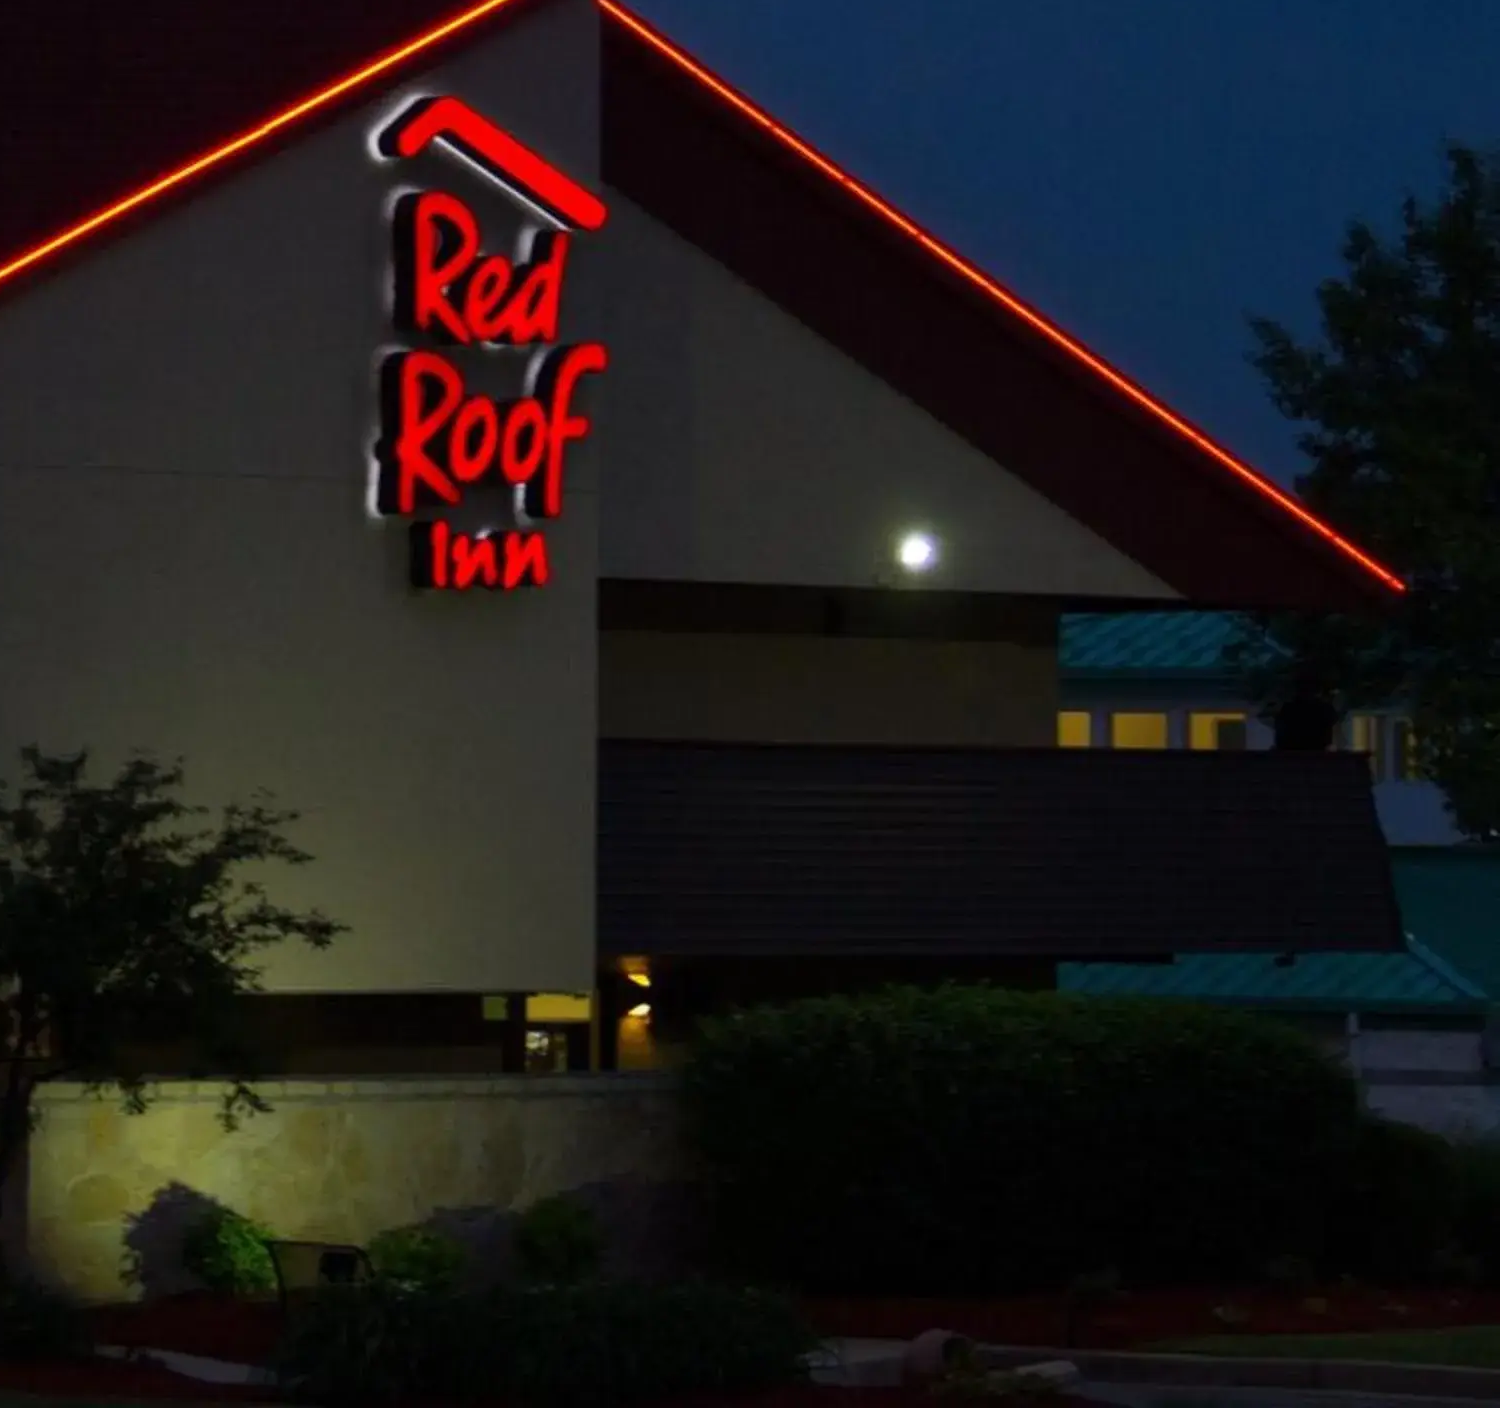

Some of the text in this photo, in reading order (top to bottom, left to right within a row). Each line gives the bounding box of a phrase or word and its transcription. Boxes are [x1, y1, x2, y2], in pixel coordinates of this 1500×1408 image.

[414, 192, 568, 344] Red
[396, 344, 607, 517] Roof
[431, 520, 549, 588] Inn
